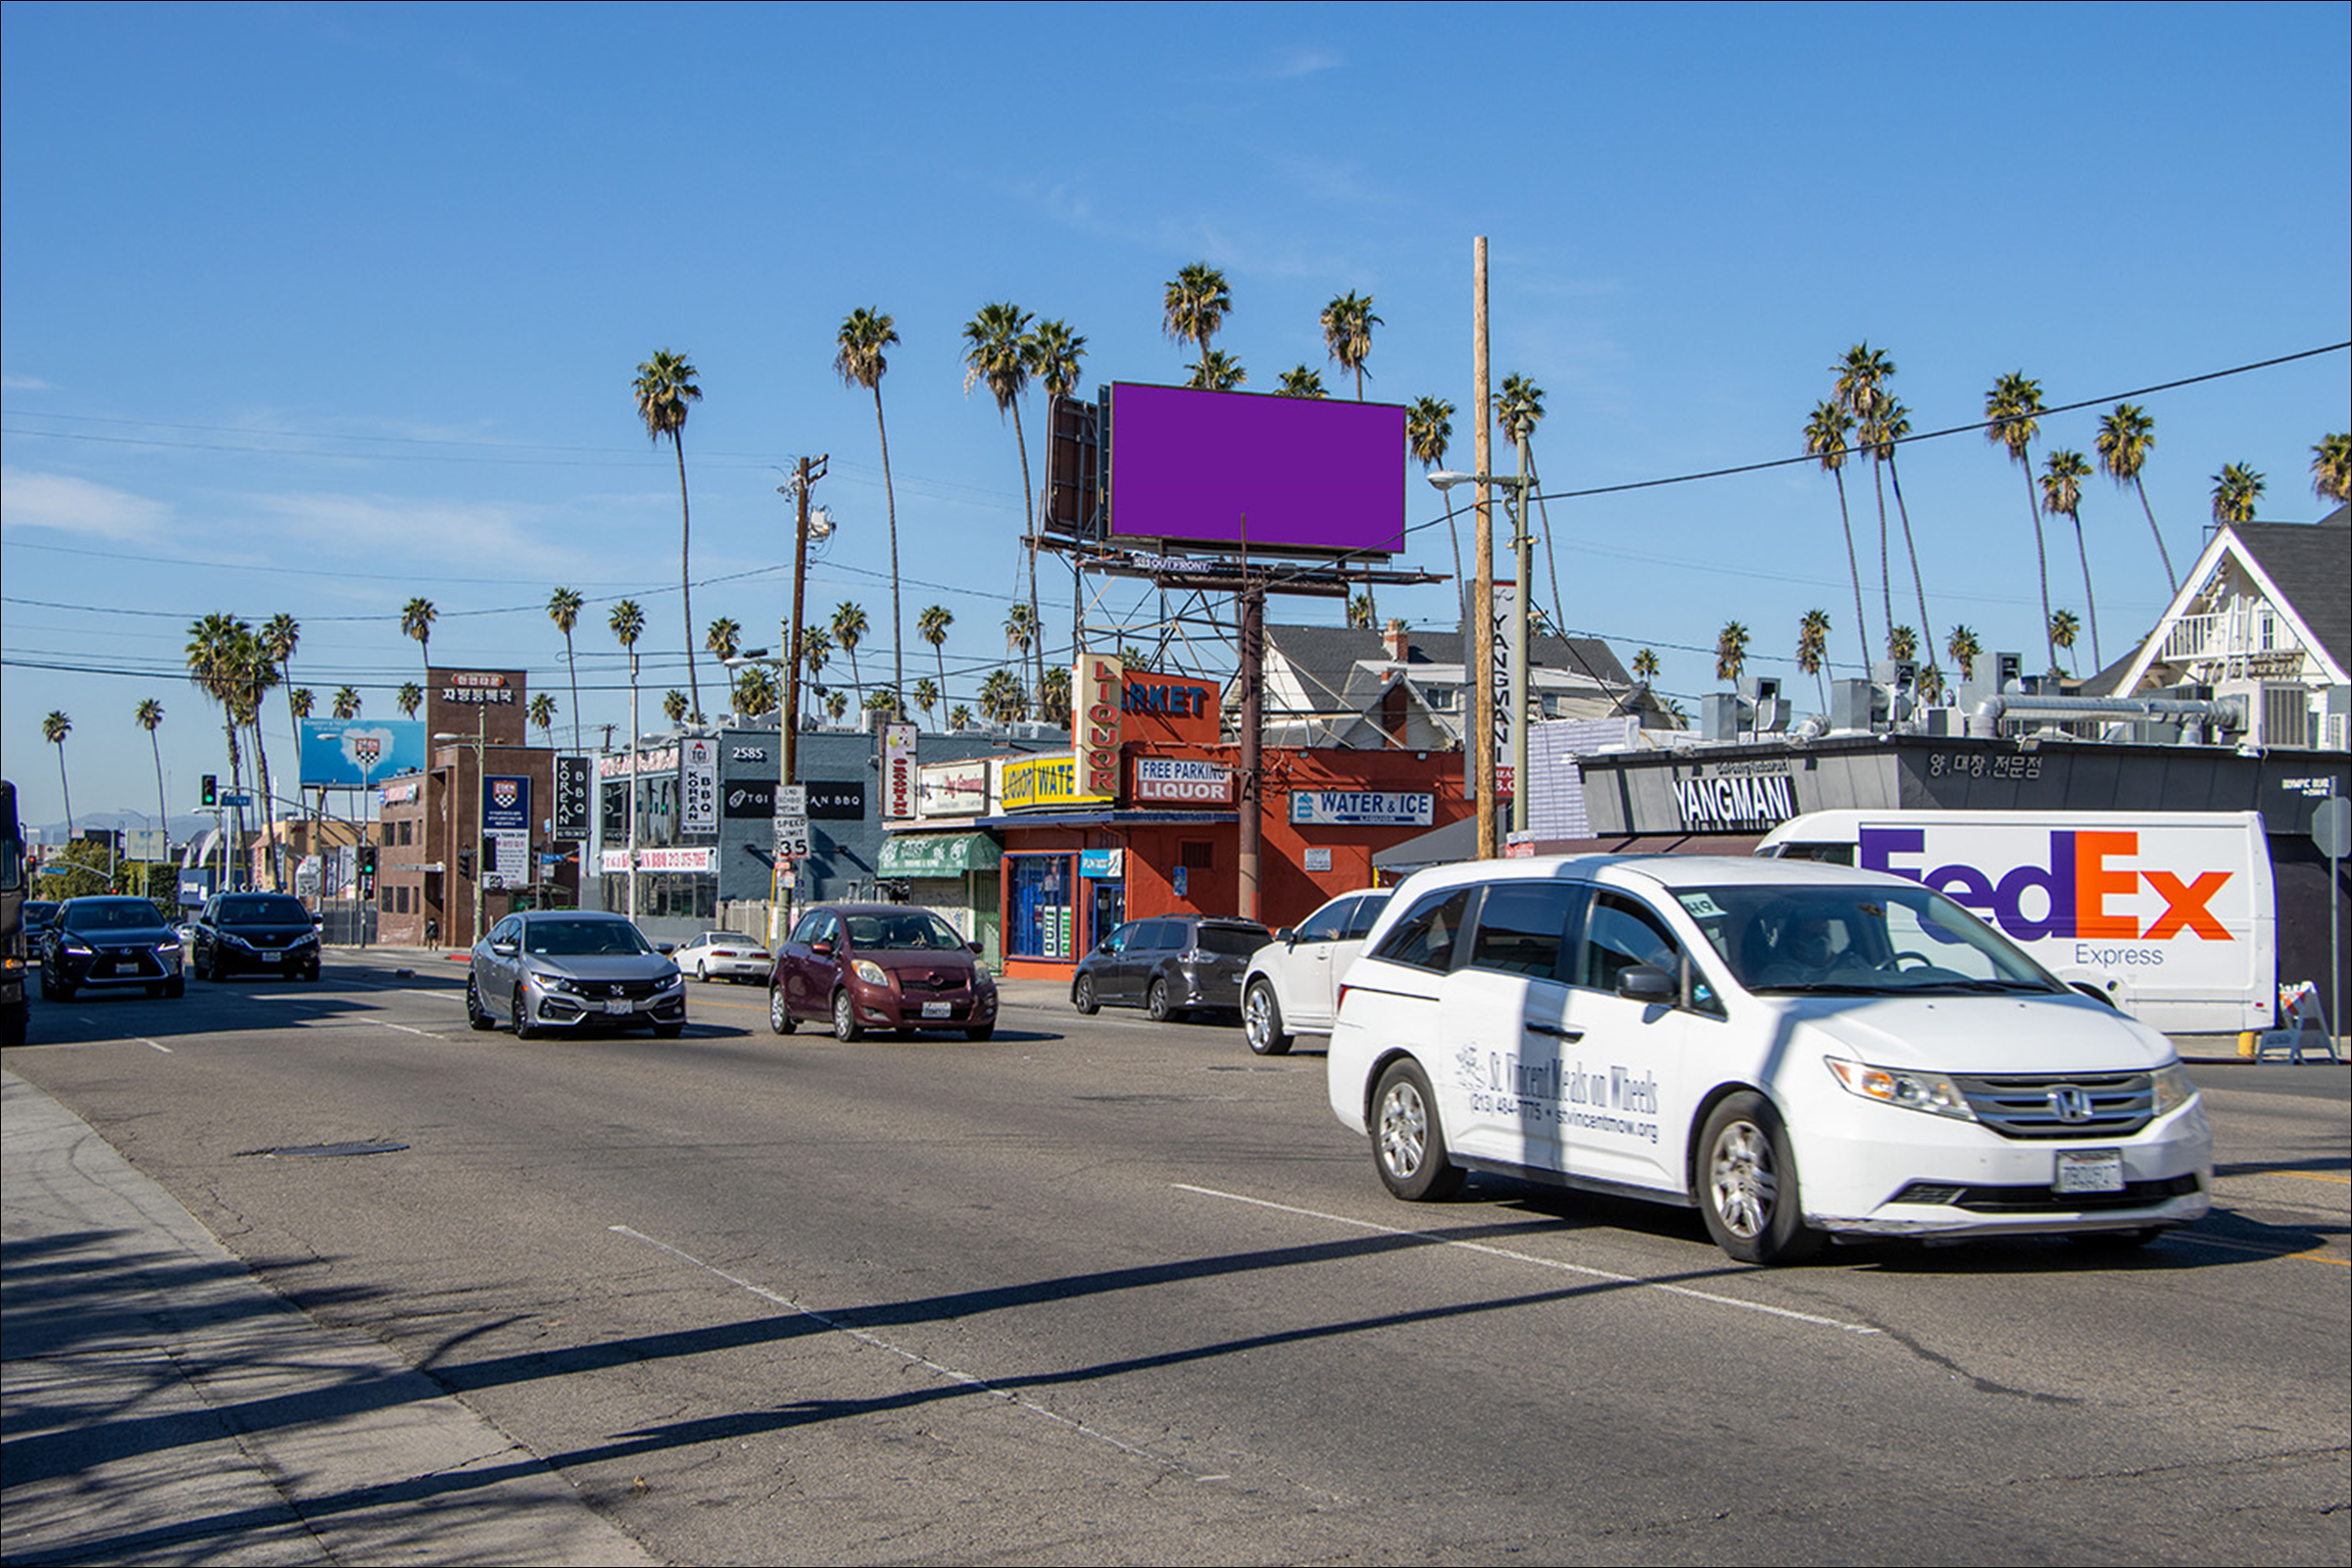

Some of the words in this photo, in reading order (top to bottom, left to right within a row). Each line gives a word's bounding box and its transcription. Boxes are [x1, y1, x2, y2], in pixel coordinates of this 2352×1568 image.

[1087, 662, 1118, 790] LIQUOR
[733, 746, 763, 760] 2585
[1143, 761, 1172, 778] FREE
[1174, 762, 1226, 780] PARKING
[559, 760, 575, 825] KOREAN
[574, 770, 585, 814] BBQ
[688, 770, 699, 820] KOREAN
[701, 776, 711, 813] BBQ
[747, 794, 768, 805] TGI
[893, 758, 907, 816] GROOMING
[1004, 766, 1033, 801] LIQUOR
[1038, 764, 1073, 796] WATE
[1143, 782, 1226, 799] LIQUOR
[1672, 776, 1793, 822] YANGMANI
[1321, 793, 1384, 813] WATER
[1387, 800, 1396, 813] &
[1399, 794, 1429, 813] ICE
[777, 818, 806, 828] SPEED
[780, 839, 808, 857] 35
[1860, 828, 2236, 942] FedEx
[2075, 944, 2165, 968] Express
[1589, 1074, 1607, 1108] on
[1610, 1064, 1658, 1115] Wheels
